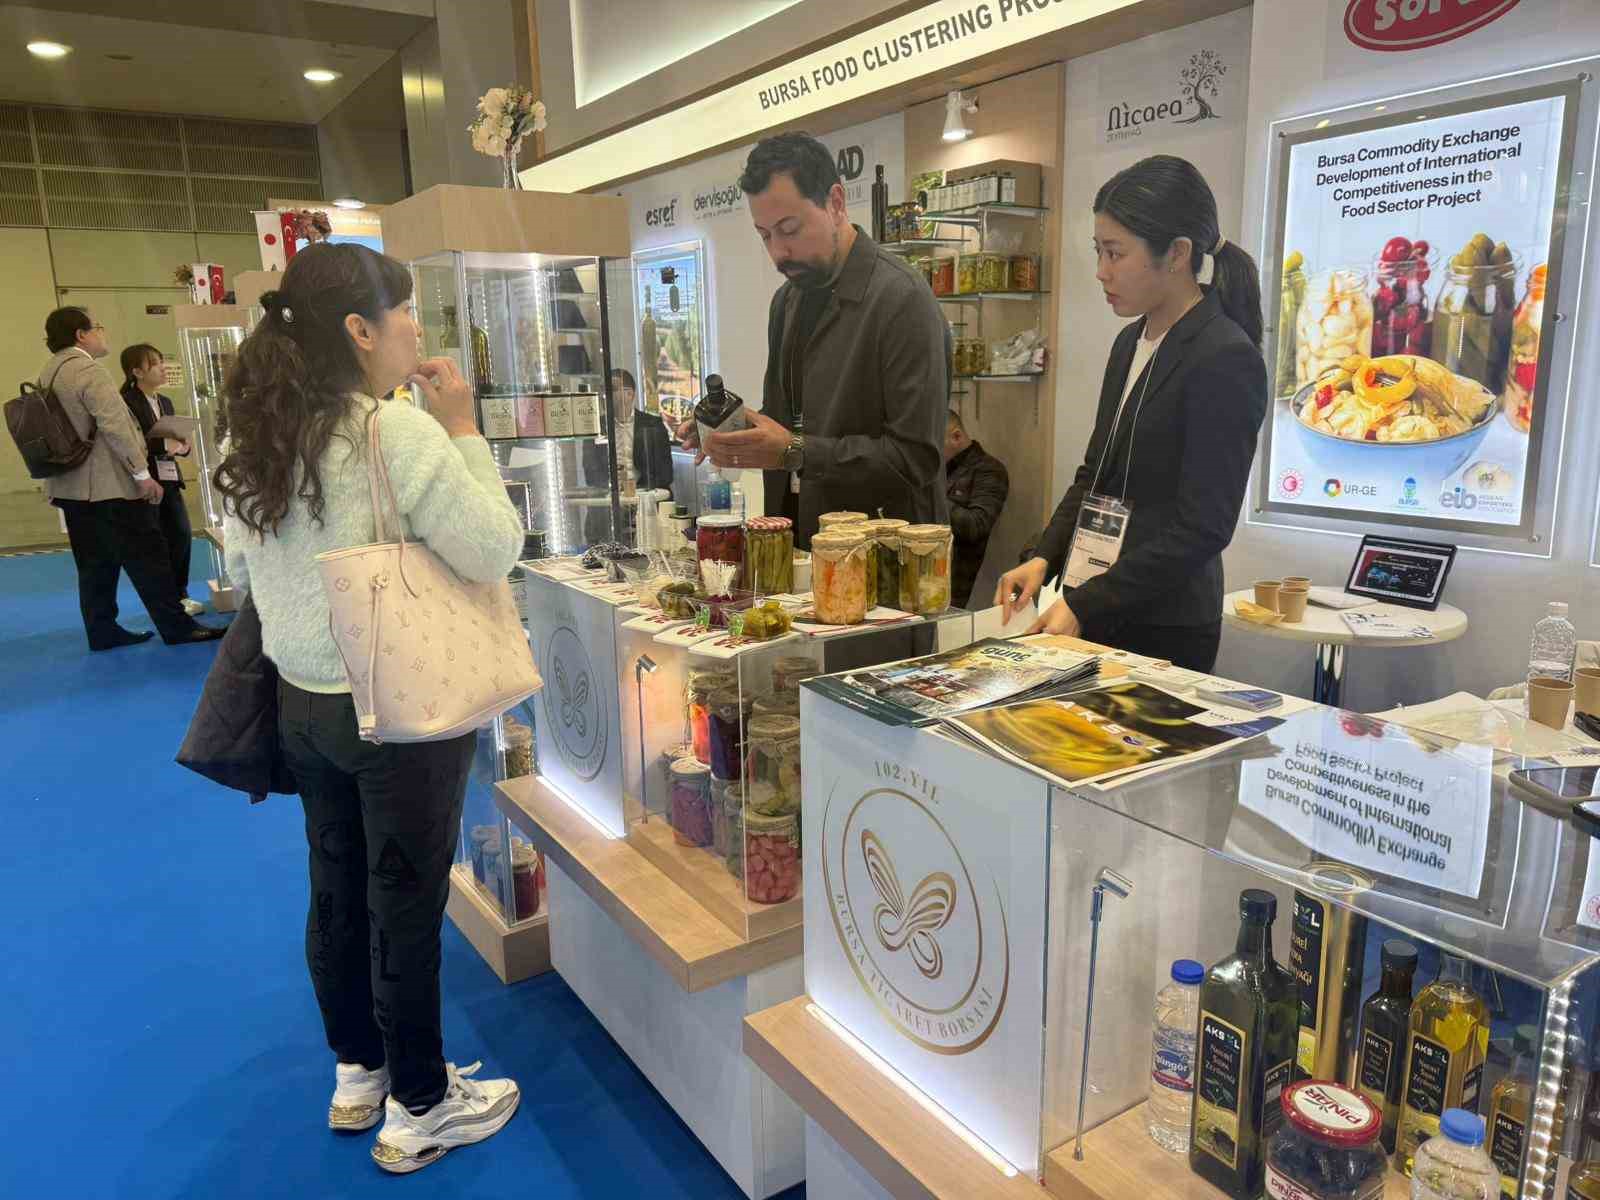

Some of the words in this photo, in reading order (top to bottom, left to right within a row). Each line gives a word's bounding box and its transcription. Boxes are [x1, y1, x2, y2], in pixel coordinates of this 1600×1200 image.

[758, 75, 812, 110] BURSA
[812, 56, 858, 90] FOOD
[863, 3, 993, 71] CLUSTERING
[1316, 161, 1404, 186] Development
[1406, 157, 1422, 172] of
[1424, 142, 1522, 170] International
[1317, 152, 1355, 168] Bursa
[1357, 138, 1440, 162] Commodity
[1442, 126, 1520, 148] Exchange
[1333, 176, 1449, 201] Competitiveness
[1451, 171, 1465, 186] in
[1467, 168, 1493, 184] the
[1341, 202, 1376, 218] Food
[1377, 197, 1425, 214] Sector
[1427, 189, 1482, 208] Project
